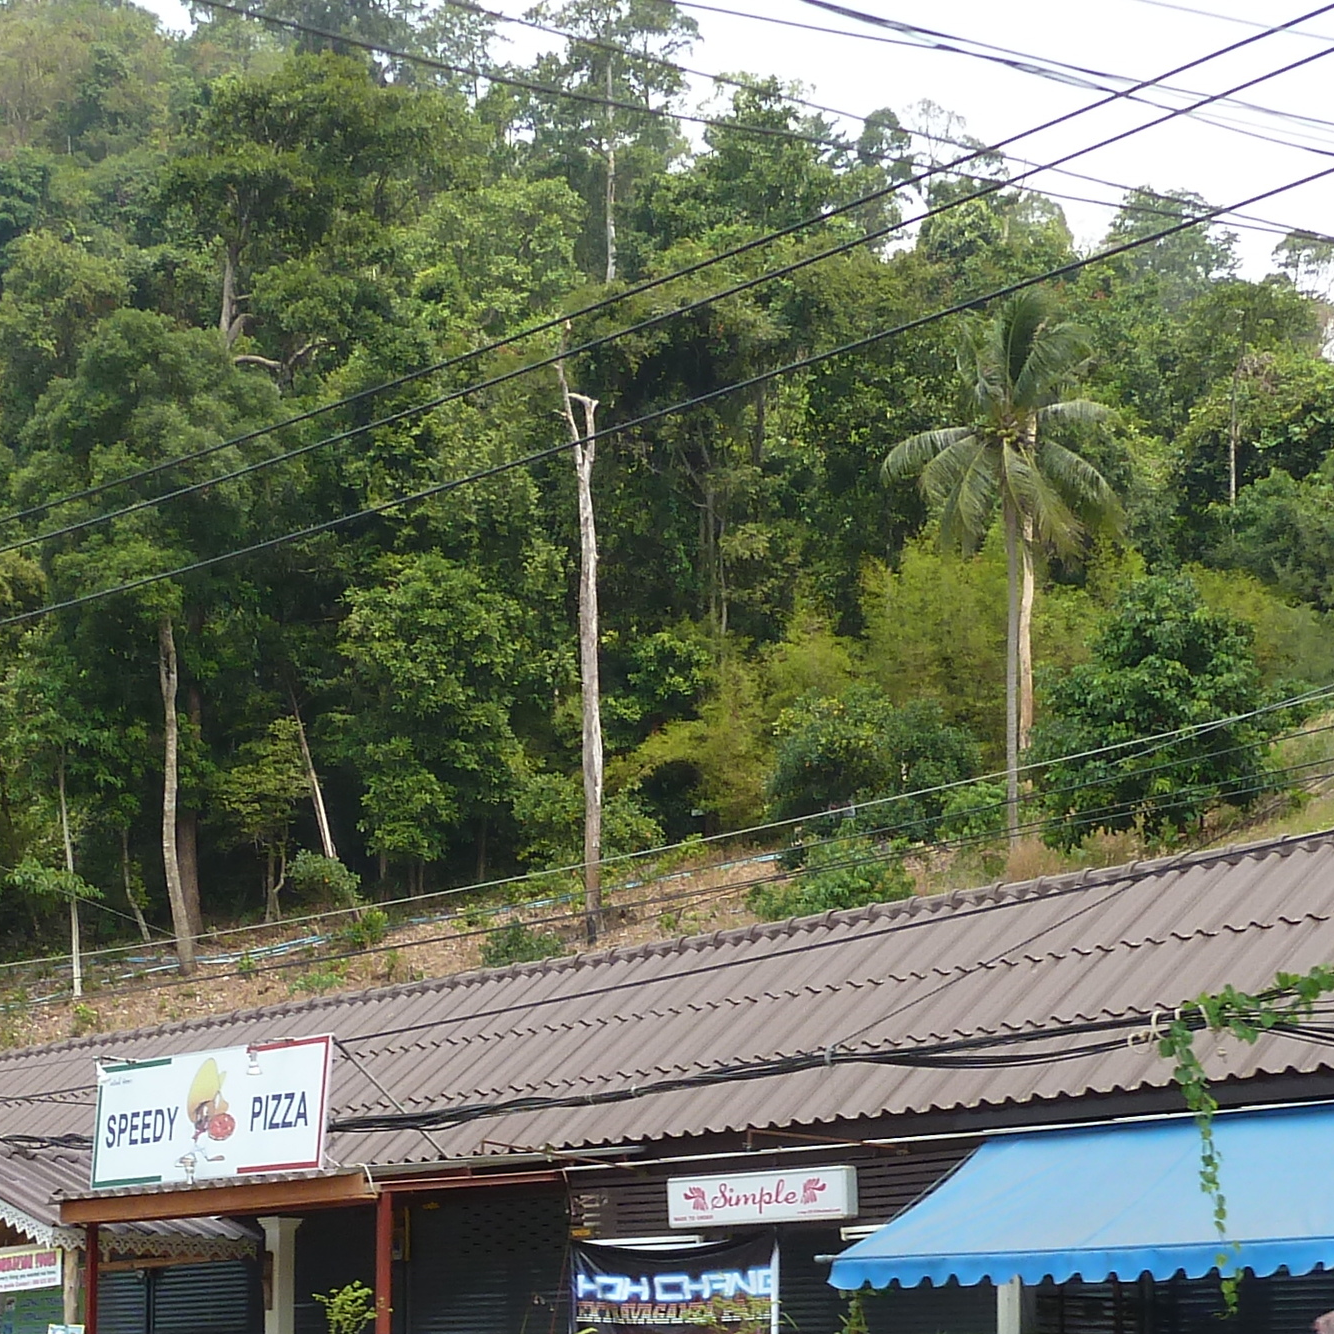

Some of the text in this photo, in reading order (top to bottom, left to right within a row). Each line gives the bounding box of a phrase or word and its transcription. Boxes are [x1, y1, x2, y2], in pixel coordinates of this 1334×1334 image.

[105, 1091, 308, 1148] SPEEDY PIZZA
[711, 1179, 799, 1214] Simple
